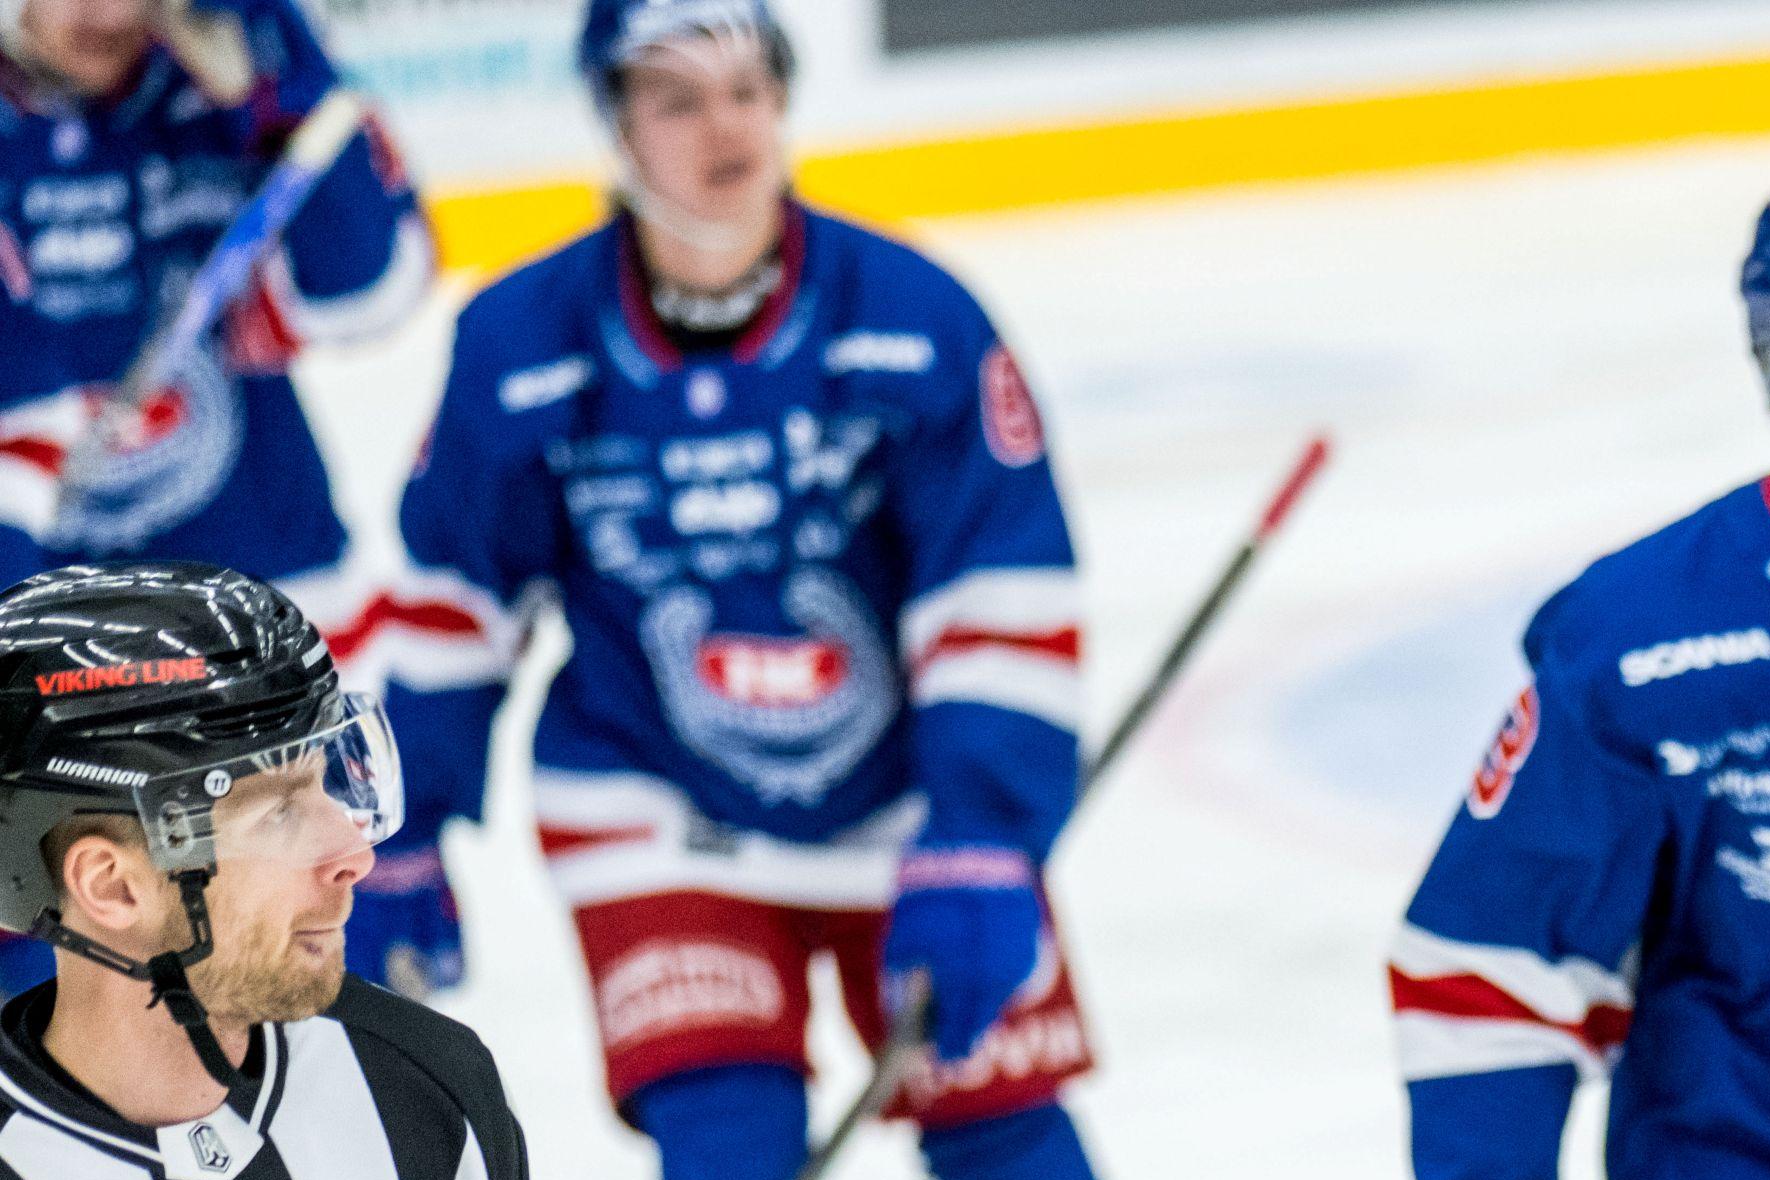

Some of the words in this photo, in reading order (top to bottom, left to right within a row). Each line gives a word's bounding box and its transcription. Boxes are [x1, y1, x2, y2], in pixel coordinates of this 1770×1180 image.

[35, 664, 137, 696] VIKING
[142, 657, 207, 684] LINE
[46, 758, 149, 788] WARRIOR
